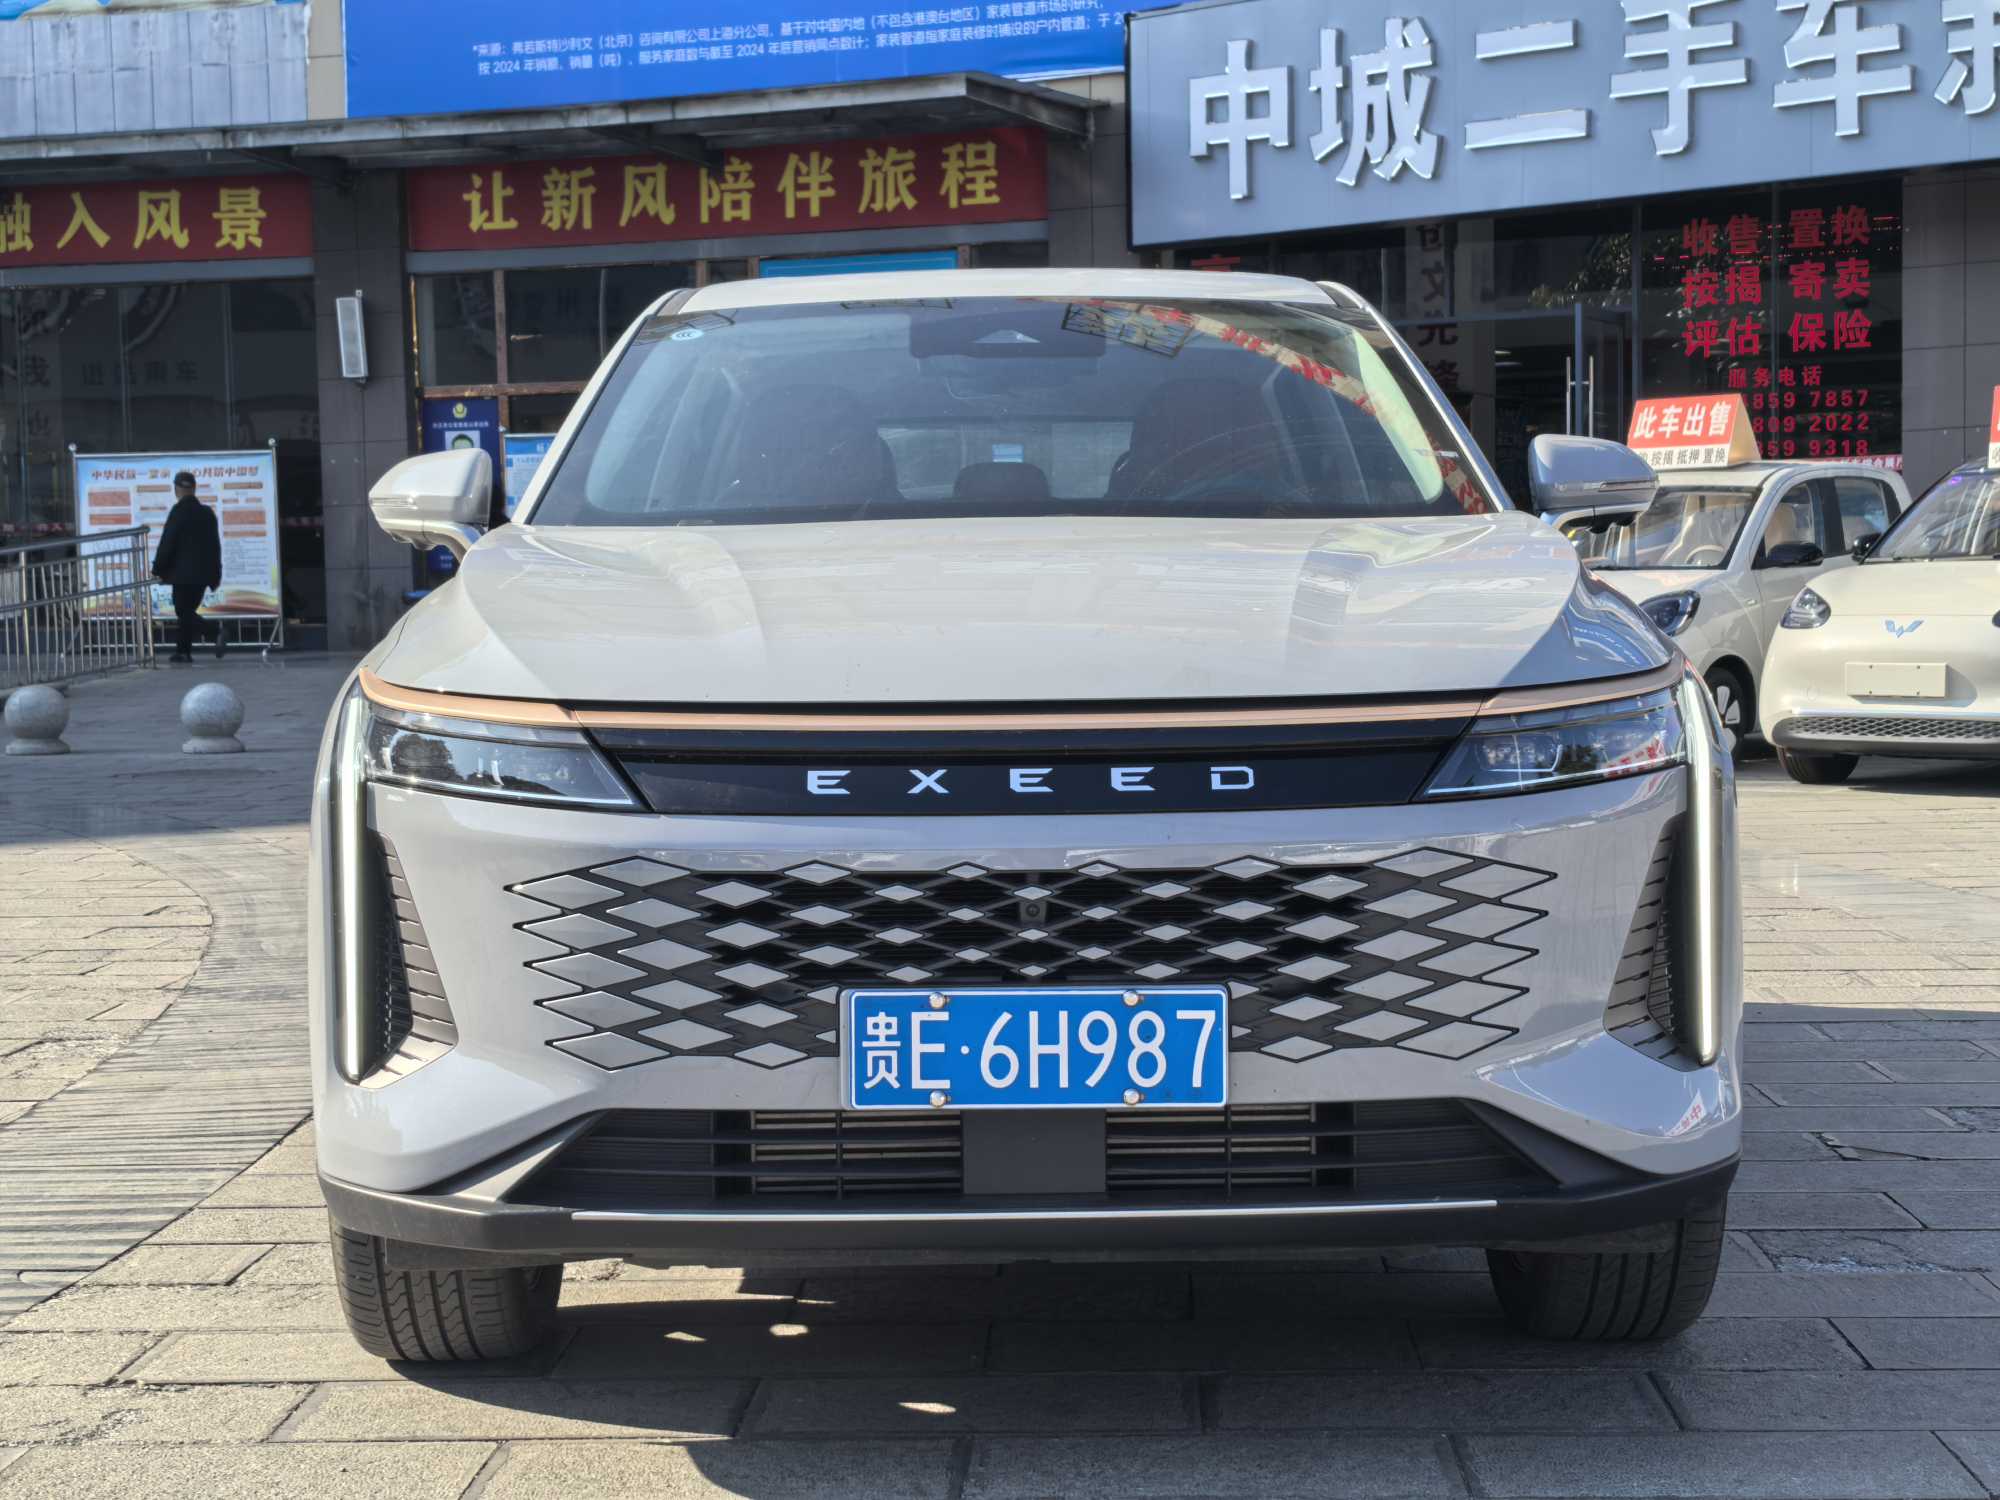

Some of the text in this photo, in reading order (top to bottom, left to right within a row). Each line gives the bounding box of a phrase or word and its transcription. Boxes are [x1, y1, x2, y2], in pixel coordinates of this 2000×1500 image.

[493, 58, 520, 74] 2024
[735, 41, 764, 57] 2024
[462, 140, 1001, 233] 让新风陪伴旅程
[1682, 205, 1871, 257] 收售 置换
[1681, 257, 1872, 308] 按揭 寄卖
[1681, 308, 1872, 358] 评估 保险
[1728, 365, 1822, 388] 服务电话
[1810, 389, 1869, 408] 7857
[1633, 400, 1731, 439] 此车出售
[1808, 413, 1870, 433] 2022
[1677, 448, 1698, 465] 抵押
[1701, 446, 1725, 463] 置换
[1808, 438, 1869, 457] 9318
[807, 766, 1255, 794] EXEED
[862, 1009, 1216, 1089] 贵E·6H987
